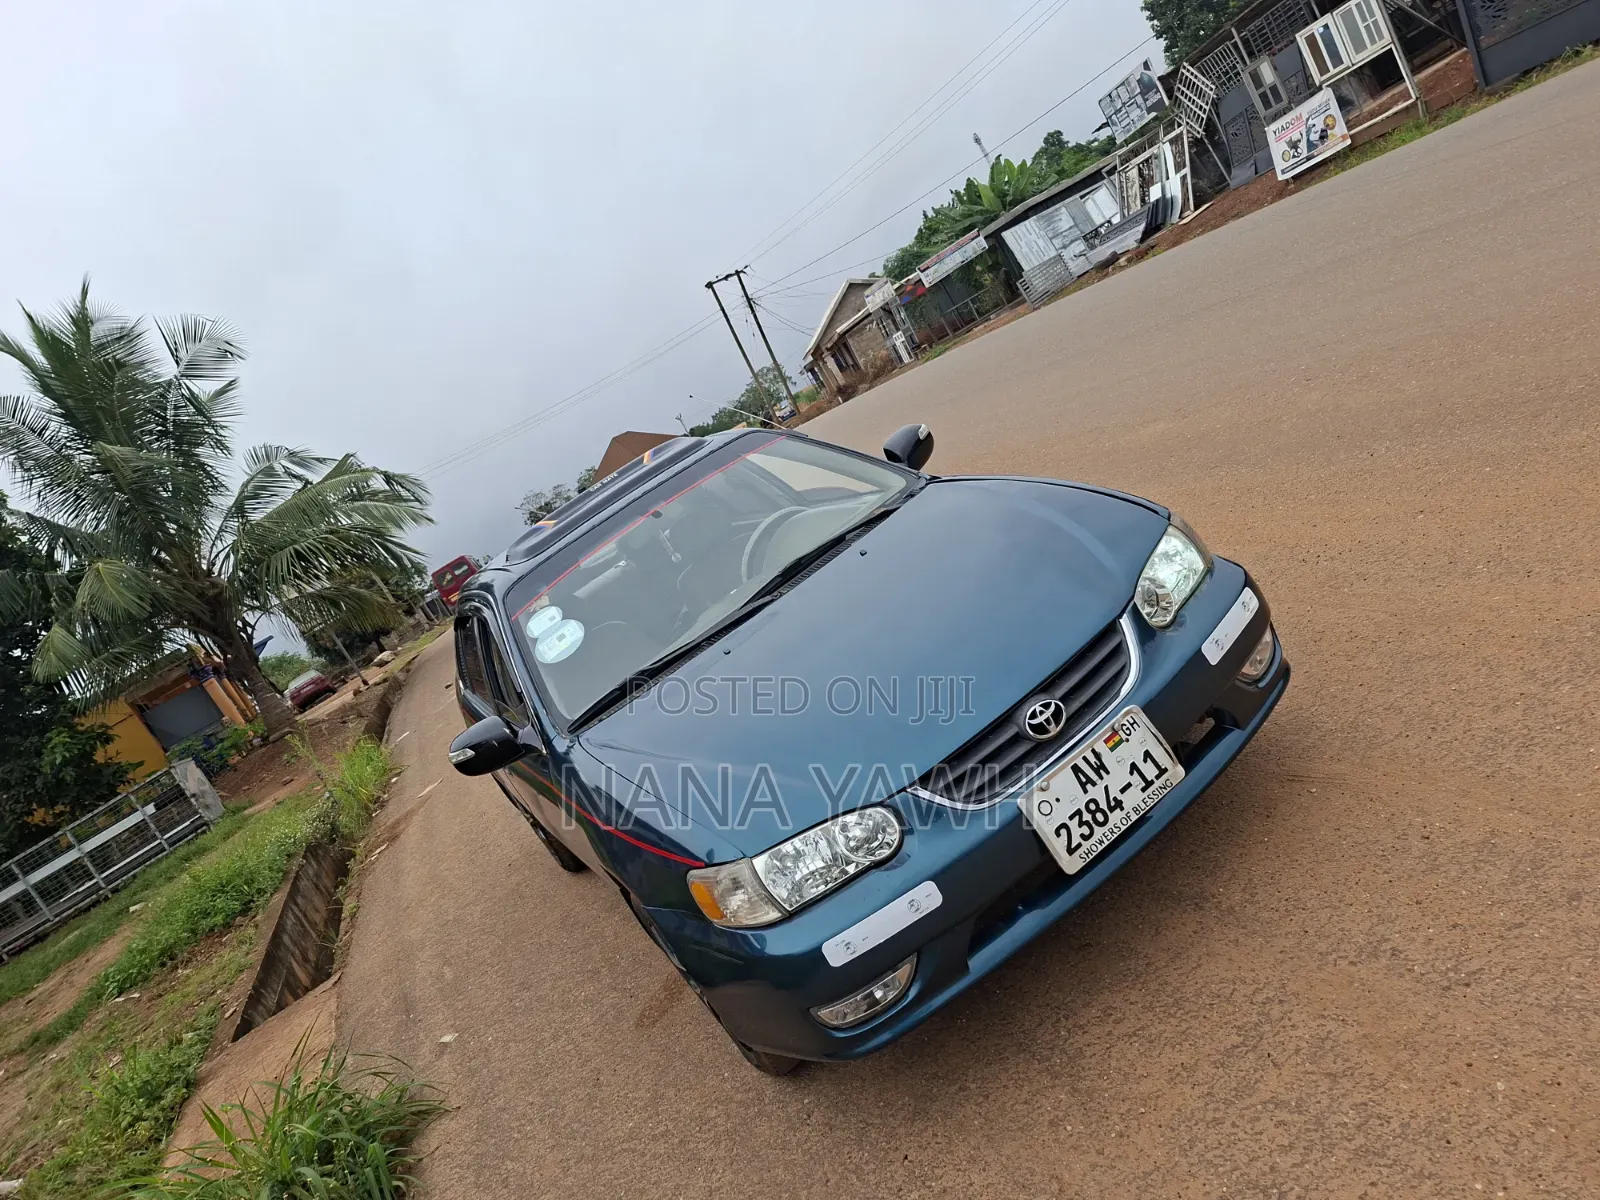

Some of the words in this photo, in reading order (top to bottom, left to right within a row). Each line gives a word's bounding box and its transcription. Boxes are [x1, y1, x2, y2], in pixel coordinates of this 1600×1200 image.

[1272, 112, 1304, 137] YIADOM
[1121, 715, 1141, 737] GH
[1070, 747, 1110, 795] AW
[1054, 748, 1169, 857] 2384-11
[1078, 823, 1122, 864] SHOWERS
[1121, 811, 1133, 827] OF
[1131, 778, 1174, 817] BLESSING
